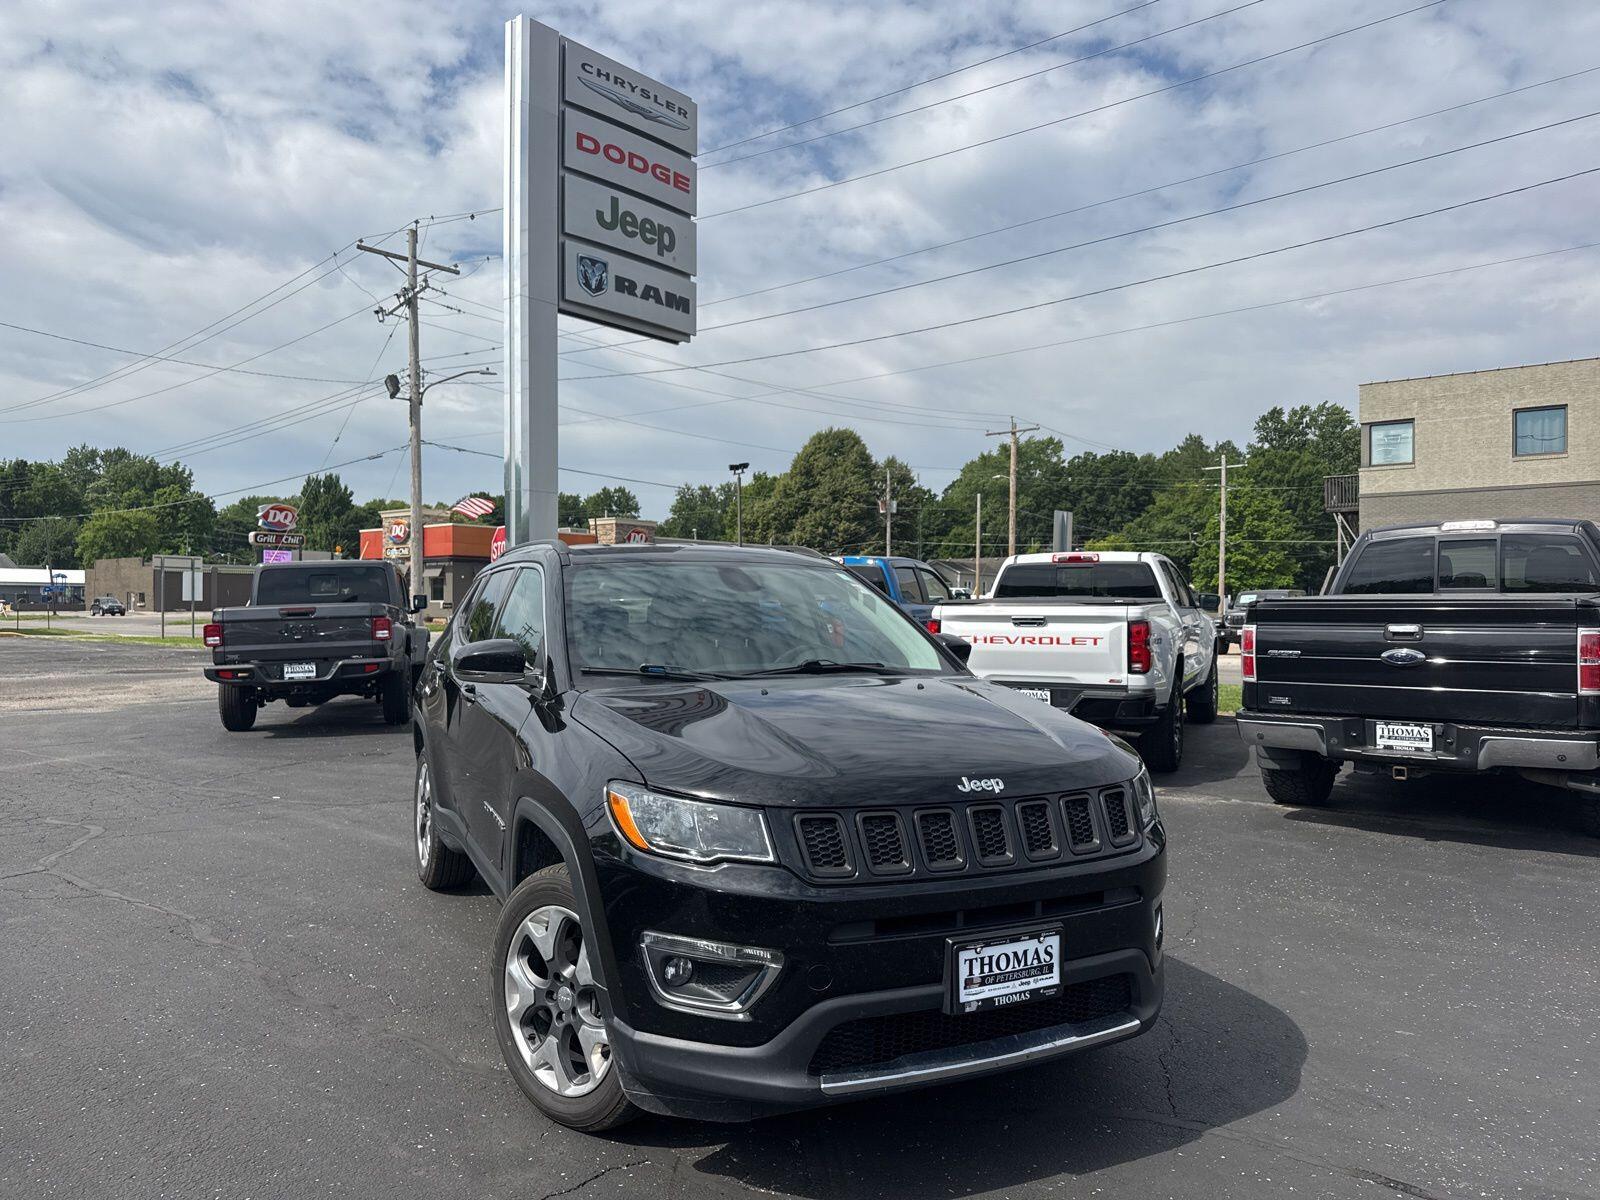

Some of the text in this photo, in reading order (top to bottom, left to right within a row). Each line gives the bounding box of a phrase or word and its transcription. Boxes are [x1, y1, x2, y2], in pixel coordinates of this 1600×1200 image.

[580, 62, 689, 119] CHRYSLER
[576, 131, 691, 194] DODGE
[595, 195, 676, 257] Jeep
[614, 274, 690, 315] RAM
[267, 509, 293, 526] DQ
[256, 534, 276, 543] Grill
[391, 524, 405, 538] DQ
[492, 541, 506, 559] STO
[1021, 691, 1049, 699] OMAS
[1379, 727, 1429, 737] THOMAS
[957, 776, 1005, 794] Jeep
[964, 944, 1054, 977] THOMAS
[984, 976, 996, 985] OF
[996, 968, 1041, 982] PETERSBURG,
[1042, 966, 1049, 974] IL
[993, 991, 1031, 1006] THOMAS
